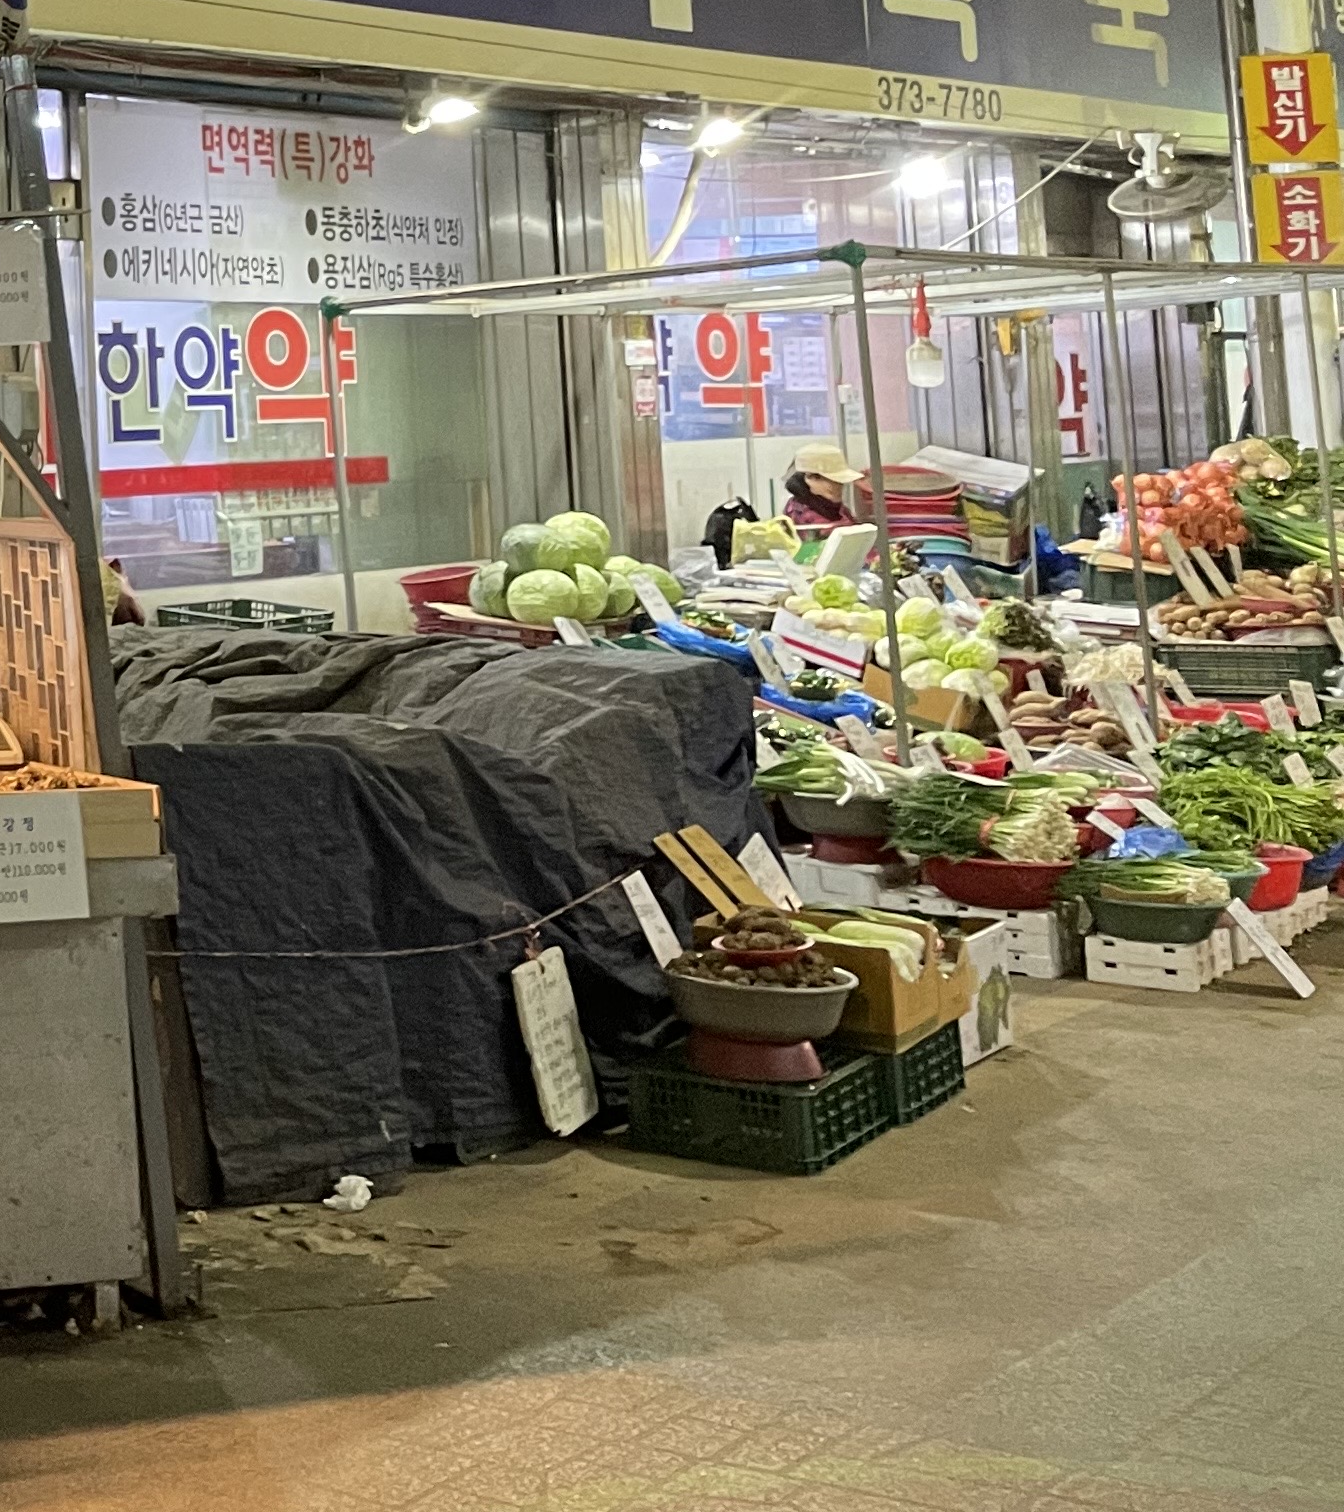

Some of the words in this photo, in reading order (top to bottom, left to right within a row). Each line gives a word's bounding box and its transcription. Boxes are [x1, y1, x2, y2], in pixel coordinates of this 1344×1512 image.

[877, 76, 1003, 123] 373-7780
[1270, 65, 1307, 142] 발신기
[201, 123, 377, 185] 면역력(특)강화
[119, 192, 205, 236] 홍삼(6년근
[208, 204, 245, 238] 금산)
[320, 206, 430, 246] 동충하초(식약처
[433, 215, 464, 248] 인정)
[1284, 184, 1320, 262] 소화기
[120, 246, 285, 288] 에키네시아(자연약초)
[323, 253, 405, 291] 용진삼(Rg5
[98, 320, 243, 443] 한약
[245, 307, 358, 457] 약
[696, 311, 772, 437] 약
